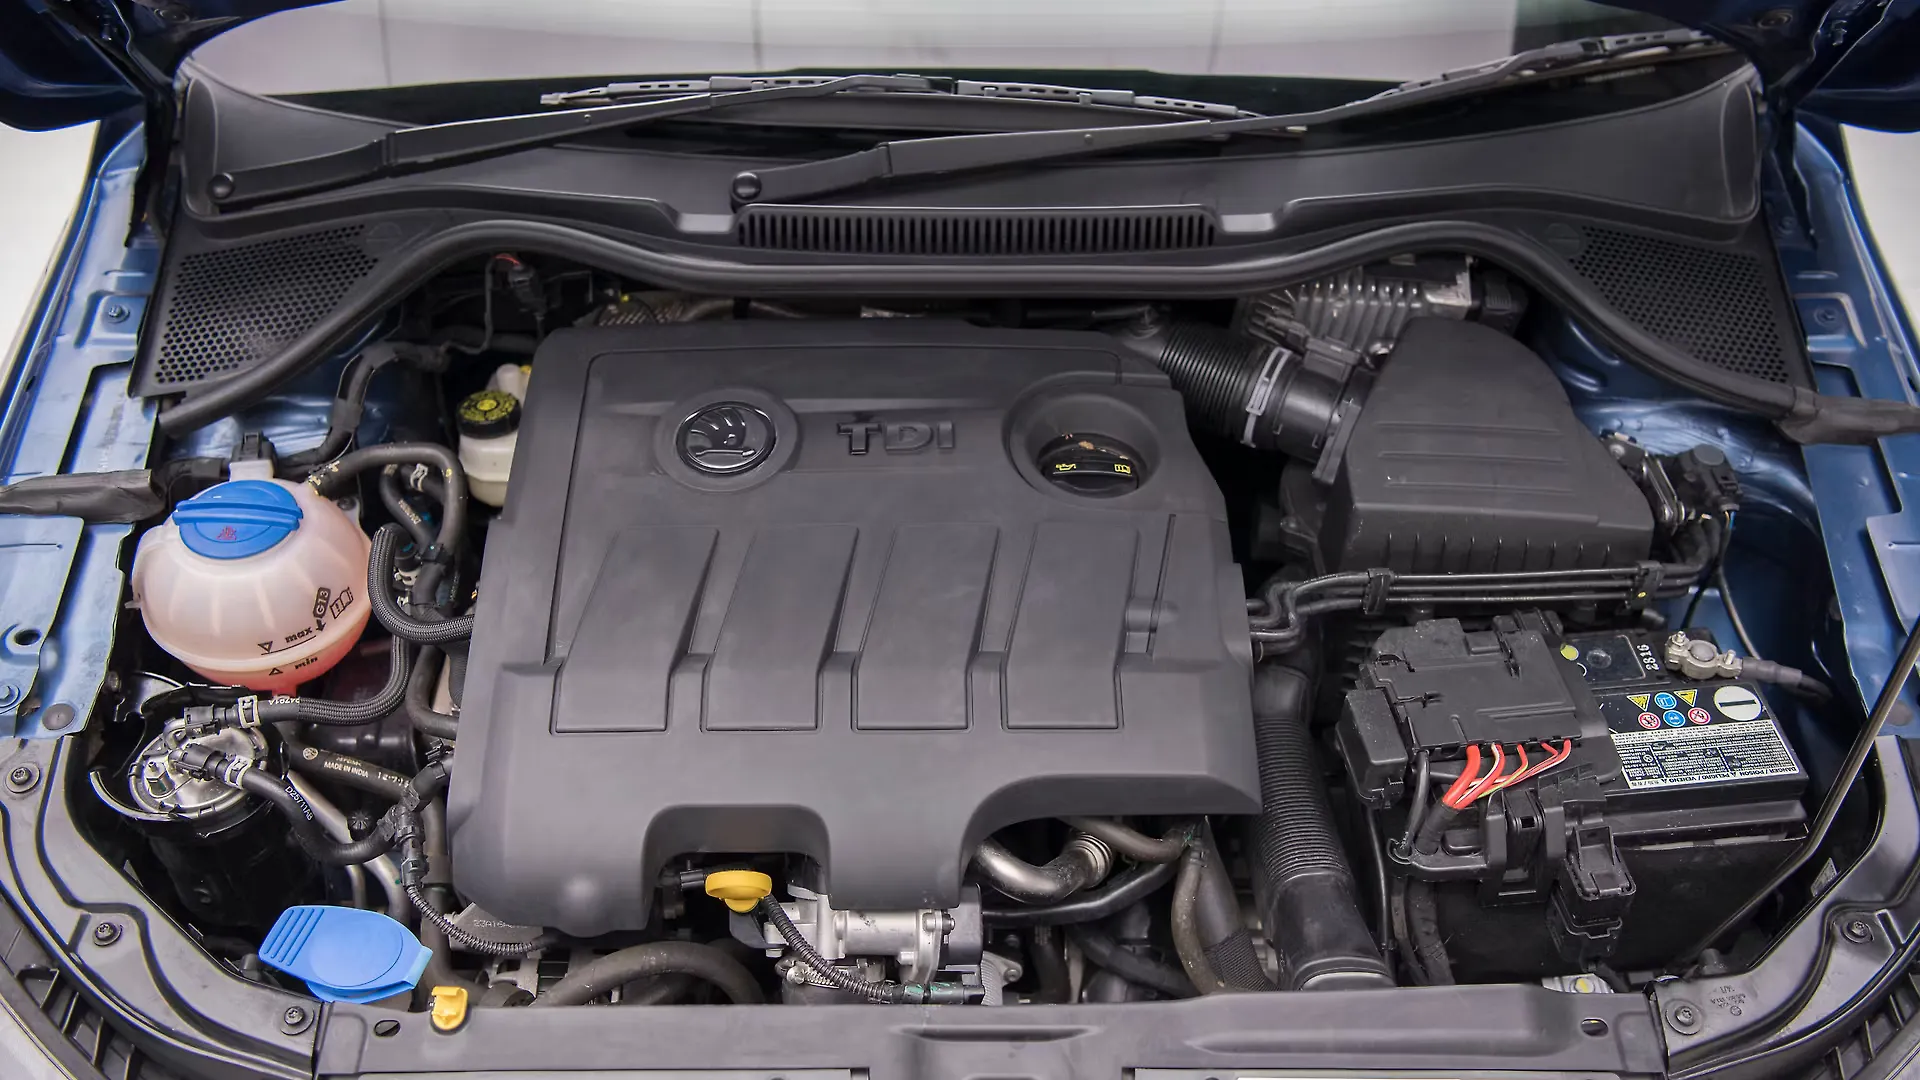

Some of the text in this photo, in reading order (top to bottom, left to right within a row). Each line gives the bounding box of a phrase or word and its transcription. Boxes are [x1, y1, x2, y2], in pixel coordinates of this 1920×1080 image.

[837, 421, 955, 455] TDI
[316, 590, 329, 615] G13
[285, 626, 313, 643] max
[294, 656, 318, 670] min
[1636, 644, 1660, 671] 2816
[323, 761, 343, 771] MADE
[351, 766, 369, 778] INDIA
[1768, 766, 1797, 774] DANGER
